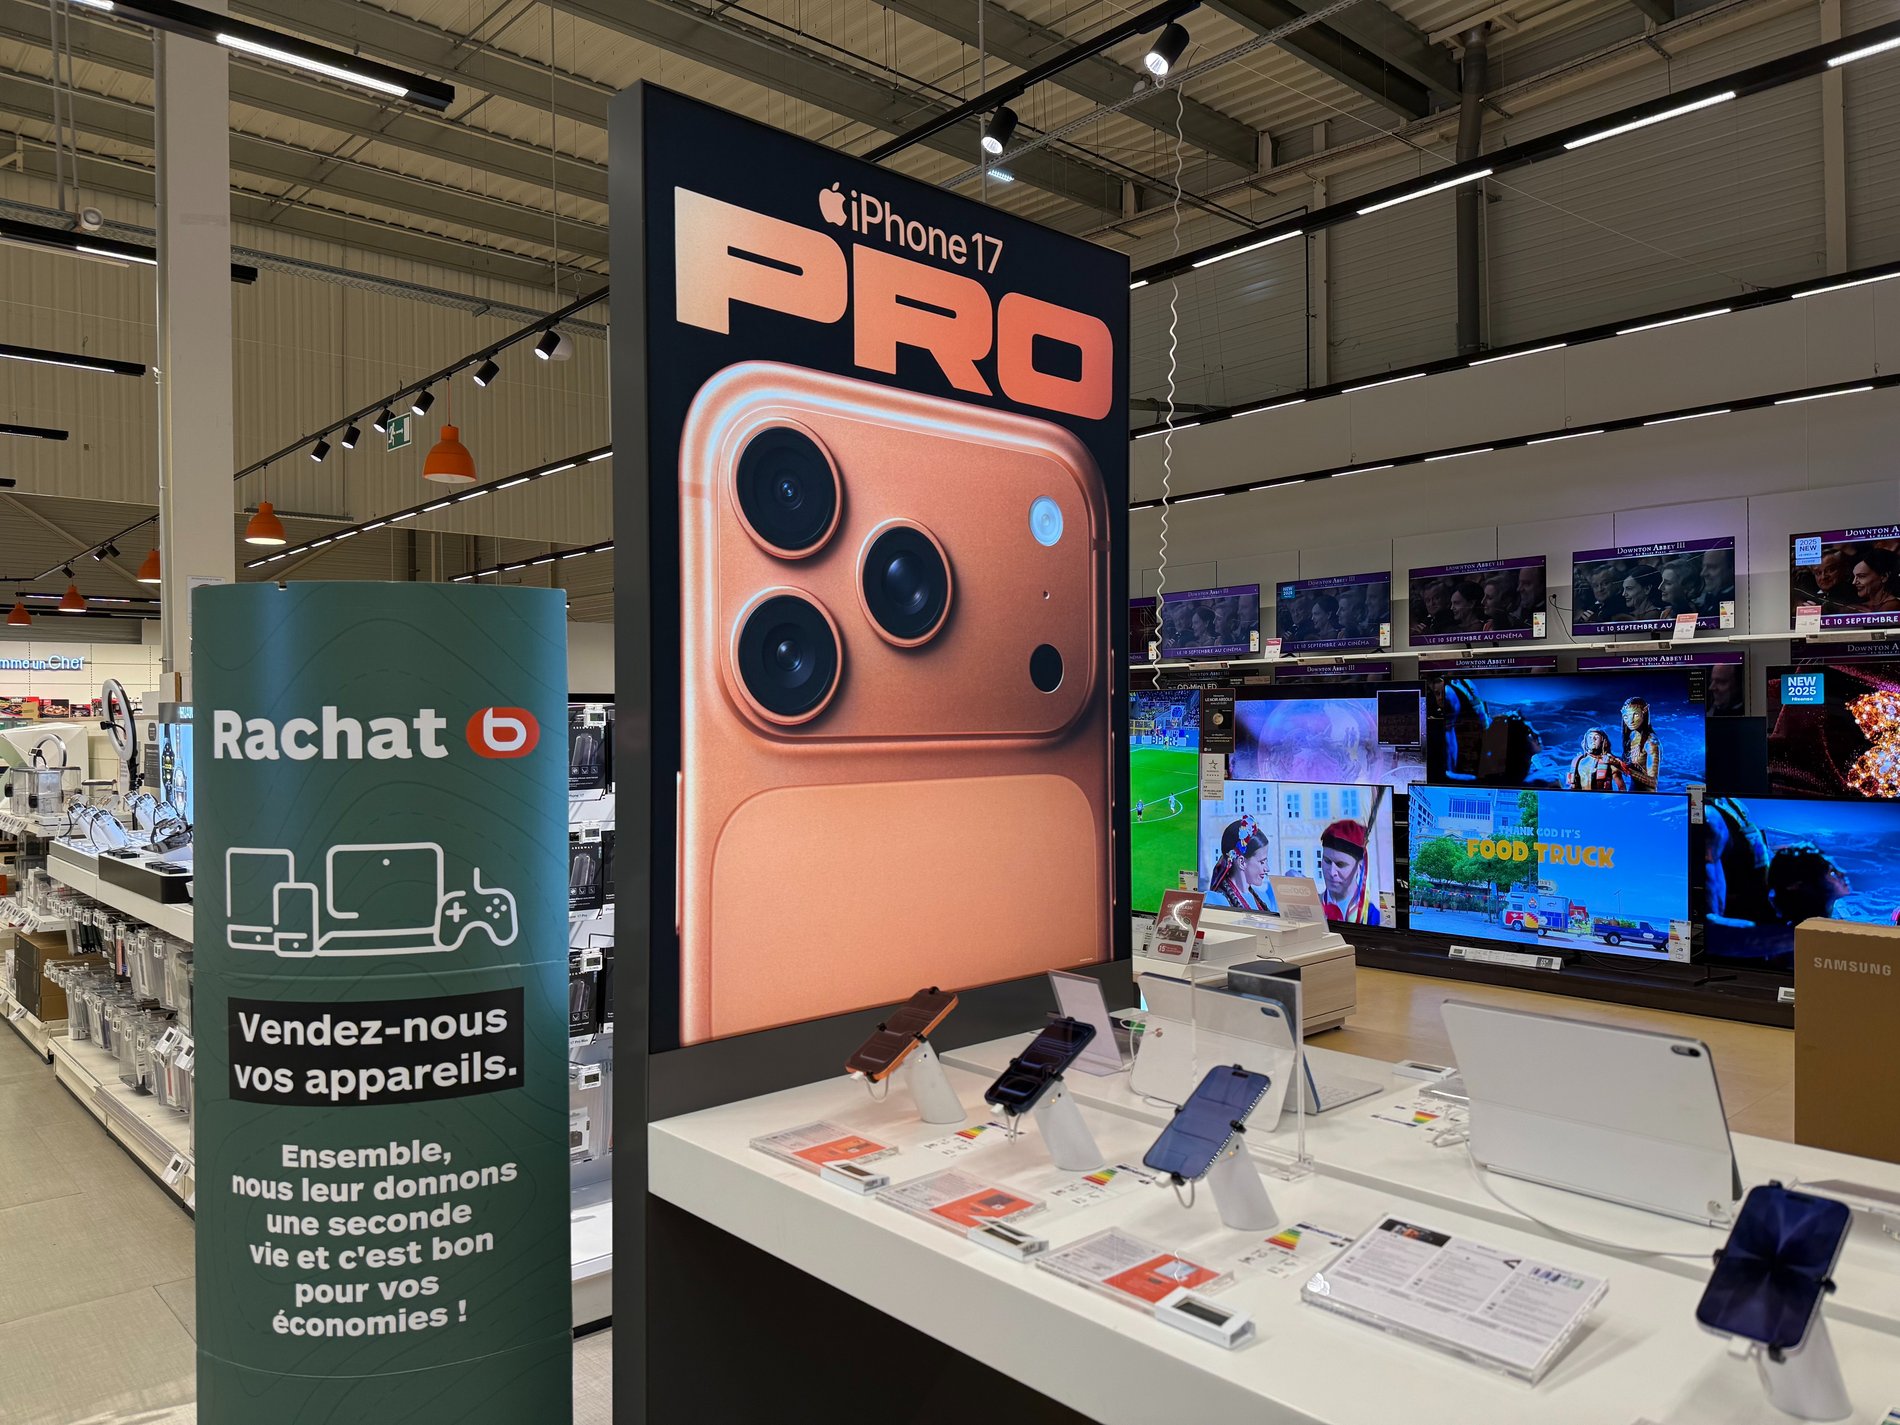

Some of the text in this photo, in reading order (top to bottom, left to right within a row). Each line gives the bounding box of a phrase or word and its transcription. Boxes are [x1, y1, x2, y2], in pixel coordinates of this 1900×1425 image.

[850, 189, 1004, 275] iPhone 17
[674, 185, 1114, 421] PRO
[1845, 527, 1889, 537] DOWNTON
[1617, 546, 1651, 554] DOWNTON
[1652, 543, 1675, 551] ABBEY
[1616, 623, 1658, 631] SEPTEMBRE
[1845, 616, 1899, 624] SEPTEMBRE
[1496, 631, 1523, 640] CINÉMA
[32, 660, 46, 670] un
[48, 655, 85, 670] Chef
[1787, 677, 1816, 687] NEW
[1788, 687, 1817, 696] 2025
[213, 706, 449, 760] Rachat
[1501, 826, 1581, 839] THANK GOD IT'S
[1467, 838, 1616, 868] FOOD TRUCK
[1813, 956, 1892, 976] SAMSUNG
[238, 1007, 508, 1046] Vendez-nous
[234, 1051, 518, 1102] vos appareils.
[282, 1139, 452, 1168] Ensemble,
[232, 1162, 518, 1202] nous leur donnons
[266, 1202, 472, 1236] une seconde
[250, 1232, 494, 1270] vie et c'est bon
[295, 1275, 440, 1308] pour vos
[272, 1307, 448, 1337] économies
